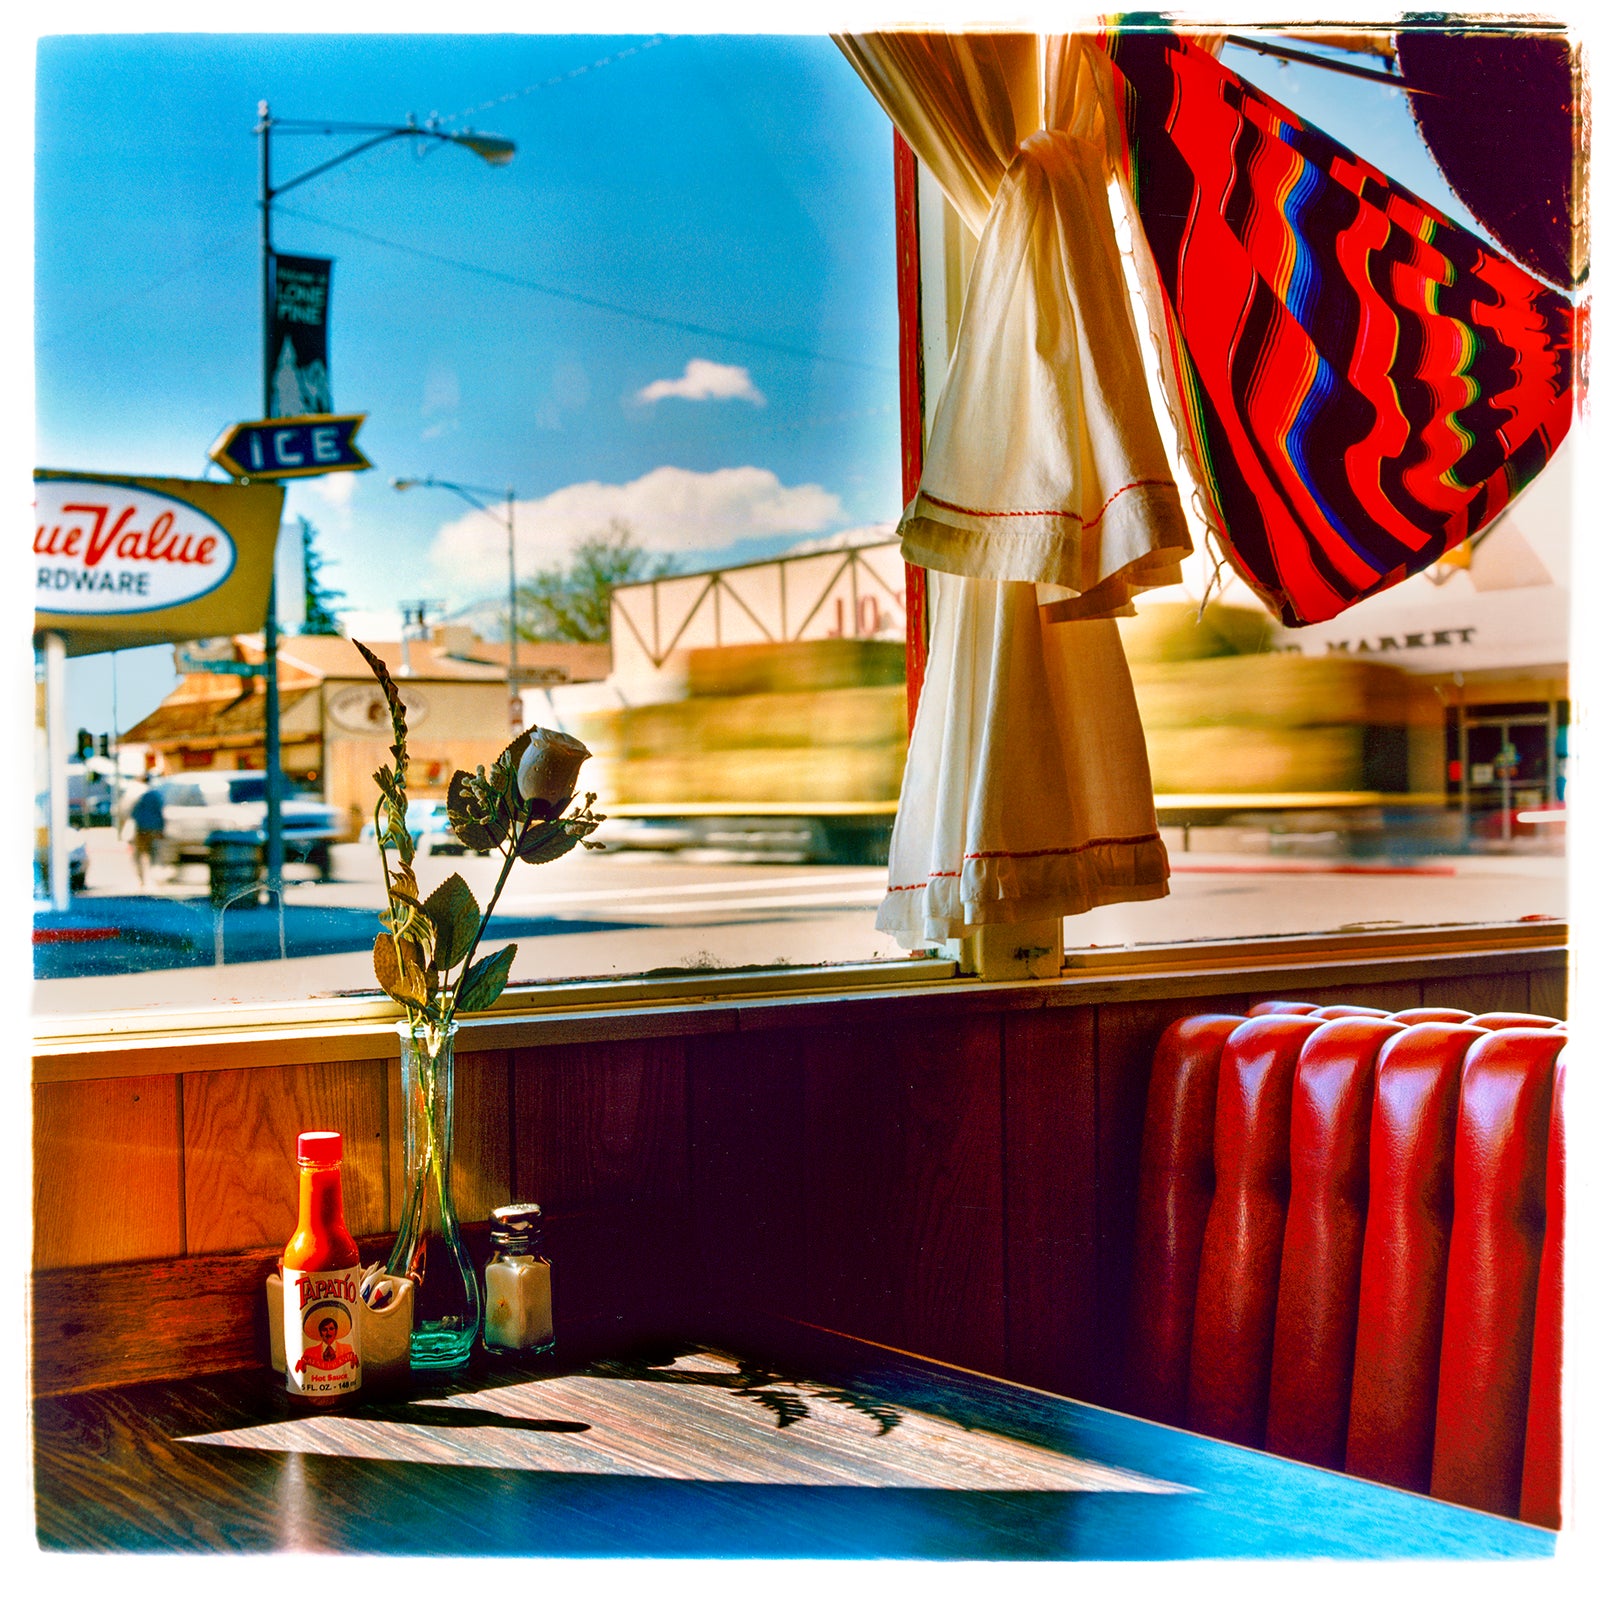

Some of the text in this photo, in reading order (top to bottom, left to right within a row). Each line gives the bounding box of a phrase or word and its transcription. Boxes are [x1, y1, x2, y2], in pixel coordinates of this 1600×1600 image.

[251, 427, 342, 469] ICE
[61, 504, 217, 566] Value
[37, 567, 150, 595] RDWARE
[1326, 627, 1475, 651] MARKET
[327, 1373, 348, 1381] Sauce
